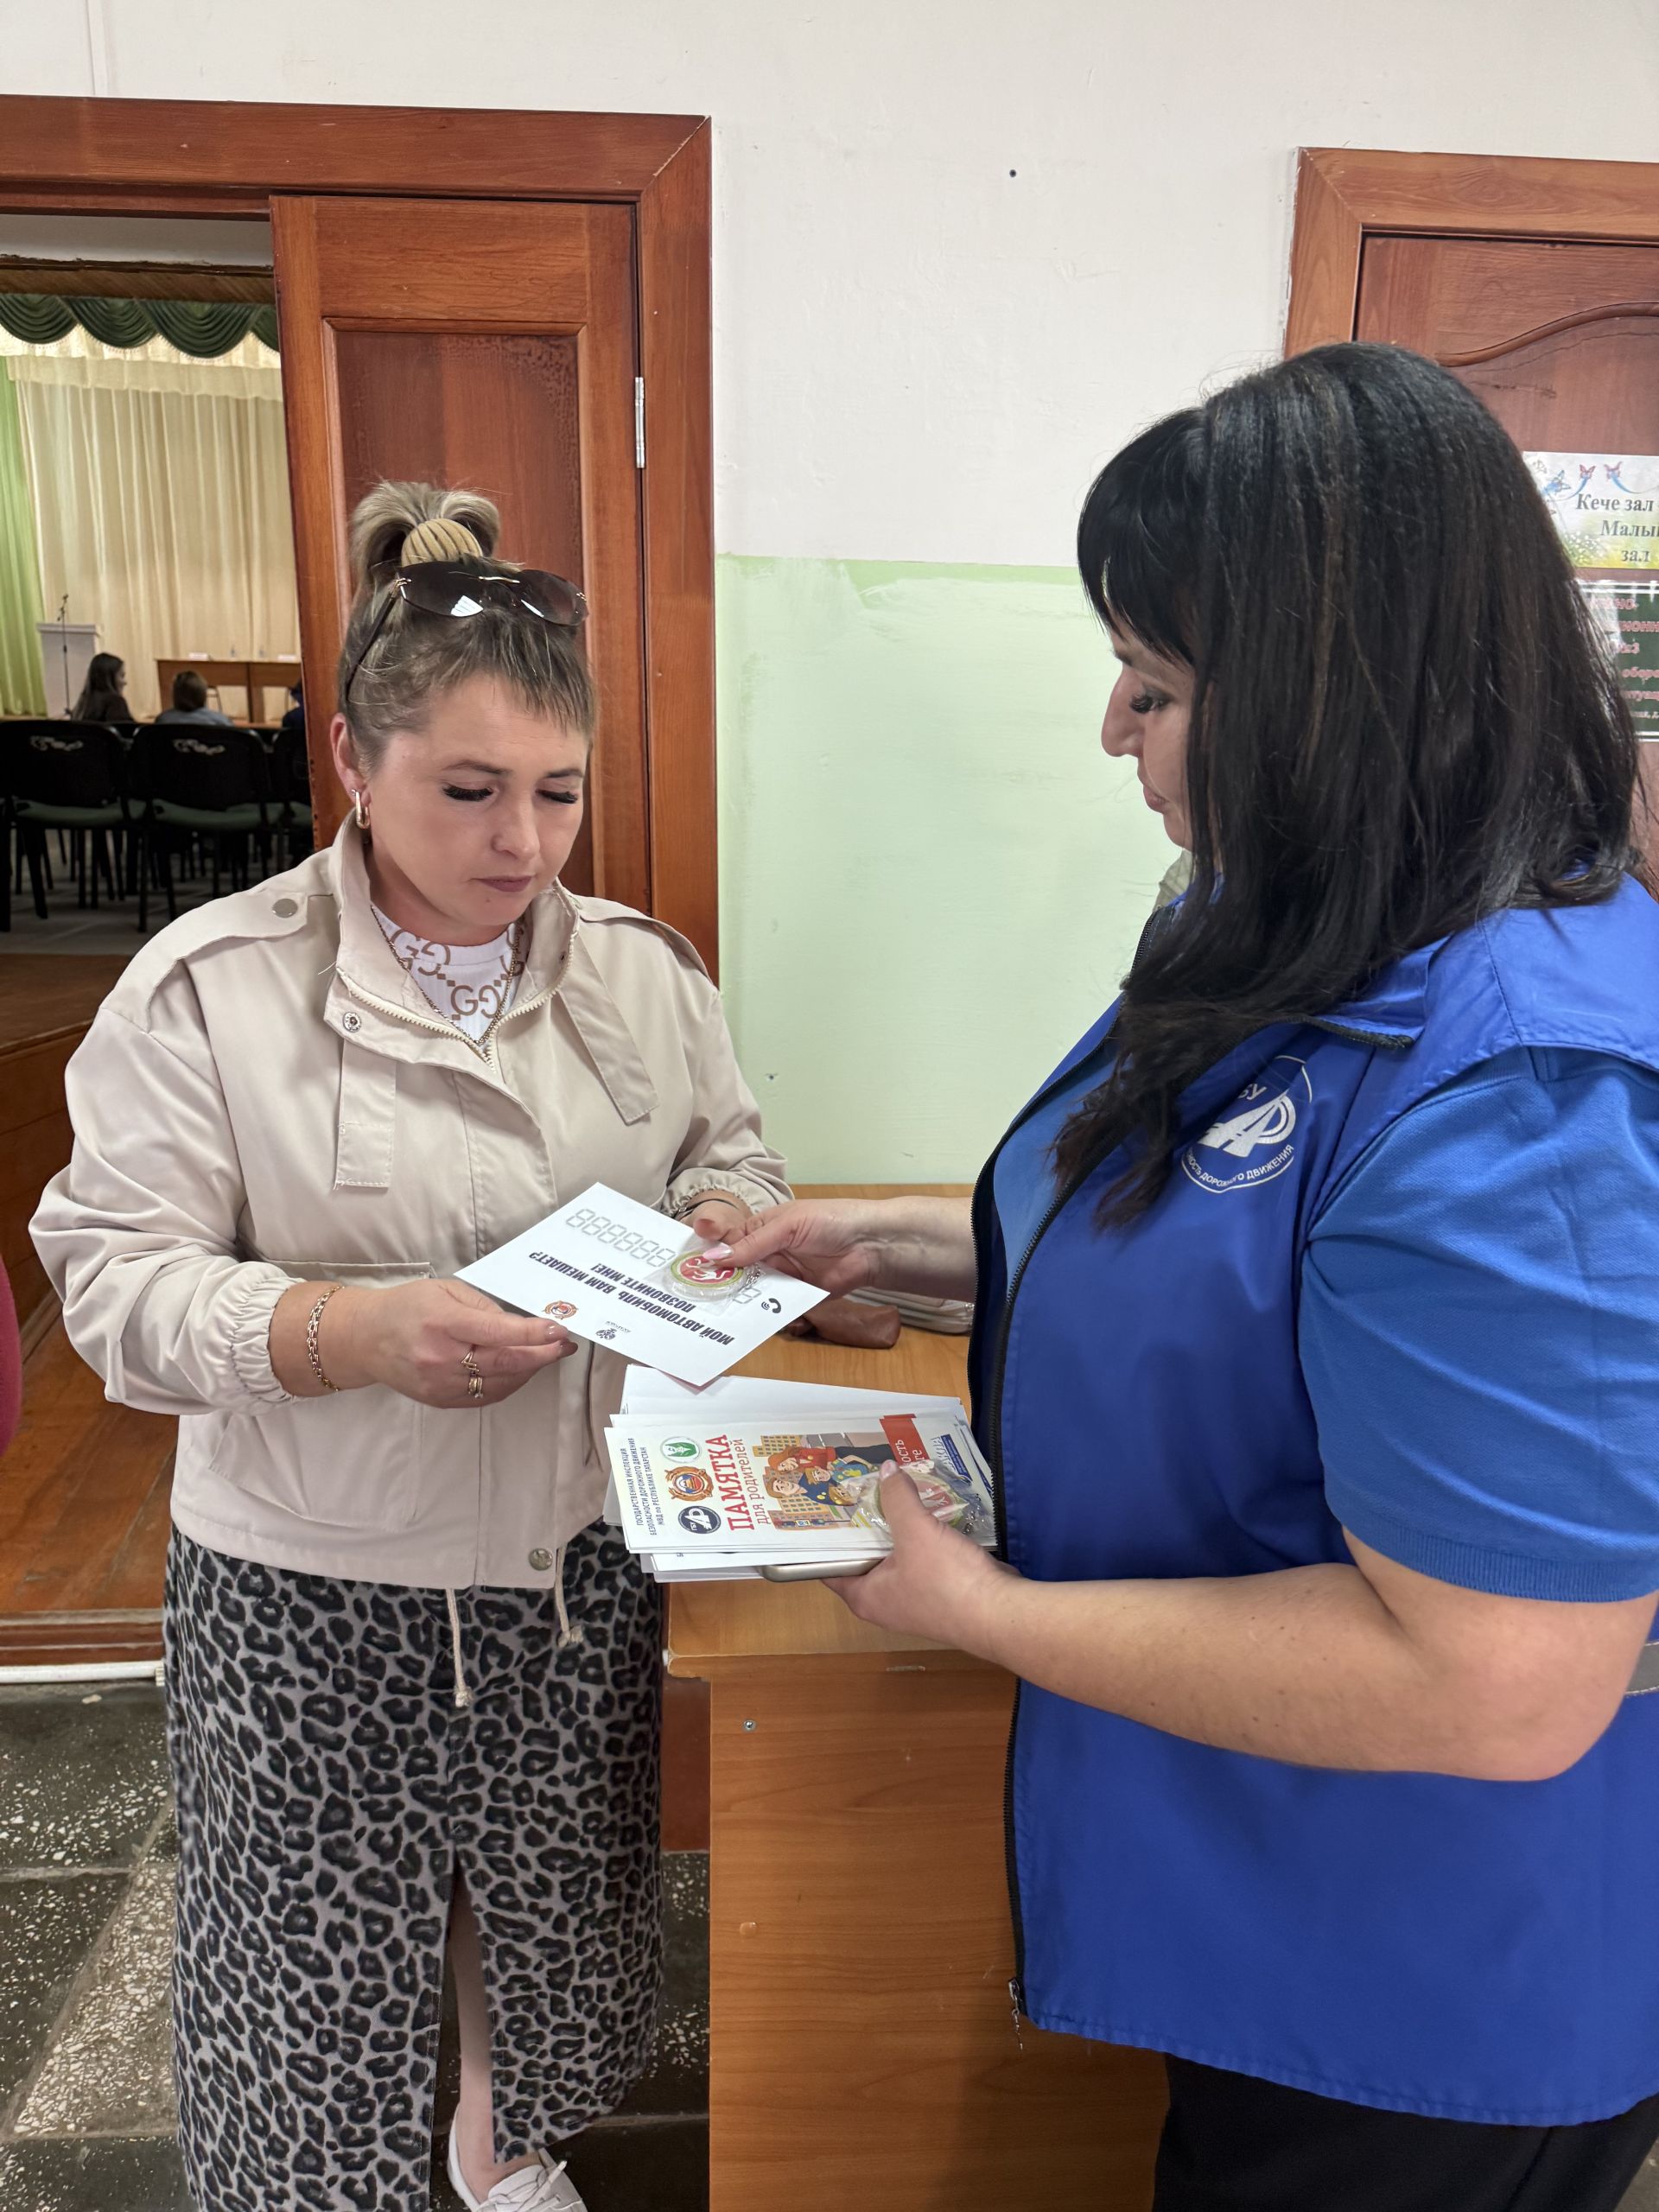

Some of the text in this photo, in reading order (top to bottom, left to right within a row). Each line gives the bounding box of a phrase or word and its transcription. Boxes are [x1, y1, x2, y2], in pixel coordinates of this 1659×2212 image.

[1576, 493, 1655, 512] Кече зал
[1600, 519, 1659, 537] Малы
[1621, 550, 1651, 562] зал
[1237, 1084, 1268, 1100] БУ
[1246, 1144, 1294, 1180] ДВИЖЕНИЯ
[529, 1251, 589, 1285] МЕШАЕТ?
[583, 1276, 617, 1294] ВАМ
[590, 1263, 696, 1313] ПОЗВОНИТЕ МНЕ!
[618, 1290, 704, 1332] АВТОМОБИЛЬ
[699, 1326, 735, 1345] МОЙ
[627, 1438, 641, 1466] ДВИЖЕНИЯ
[640, 1447, 652, 1472] ТАТАРСТАН
[895, 1440, 911, 1464] ость
[912, 1449, 925, 1461] ге
[620, 1447, 644, 1526] ГОСУДАРСТВЕННАЯ ИНСПЕКЦИЯ
[645, 1473, 659, 1506] РЕСПУБЛИКЕ
[705, 1434, 754, 1530] ПАМЯТКА
[730, 1439, 772, 1524] для родителей
[641, 1497, 657, 1535] БЕЗОПАСНОСТИ
[656, 1514, 664, 1526] МВД
